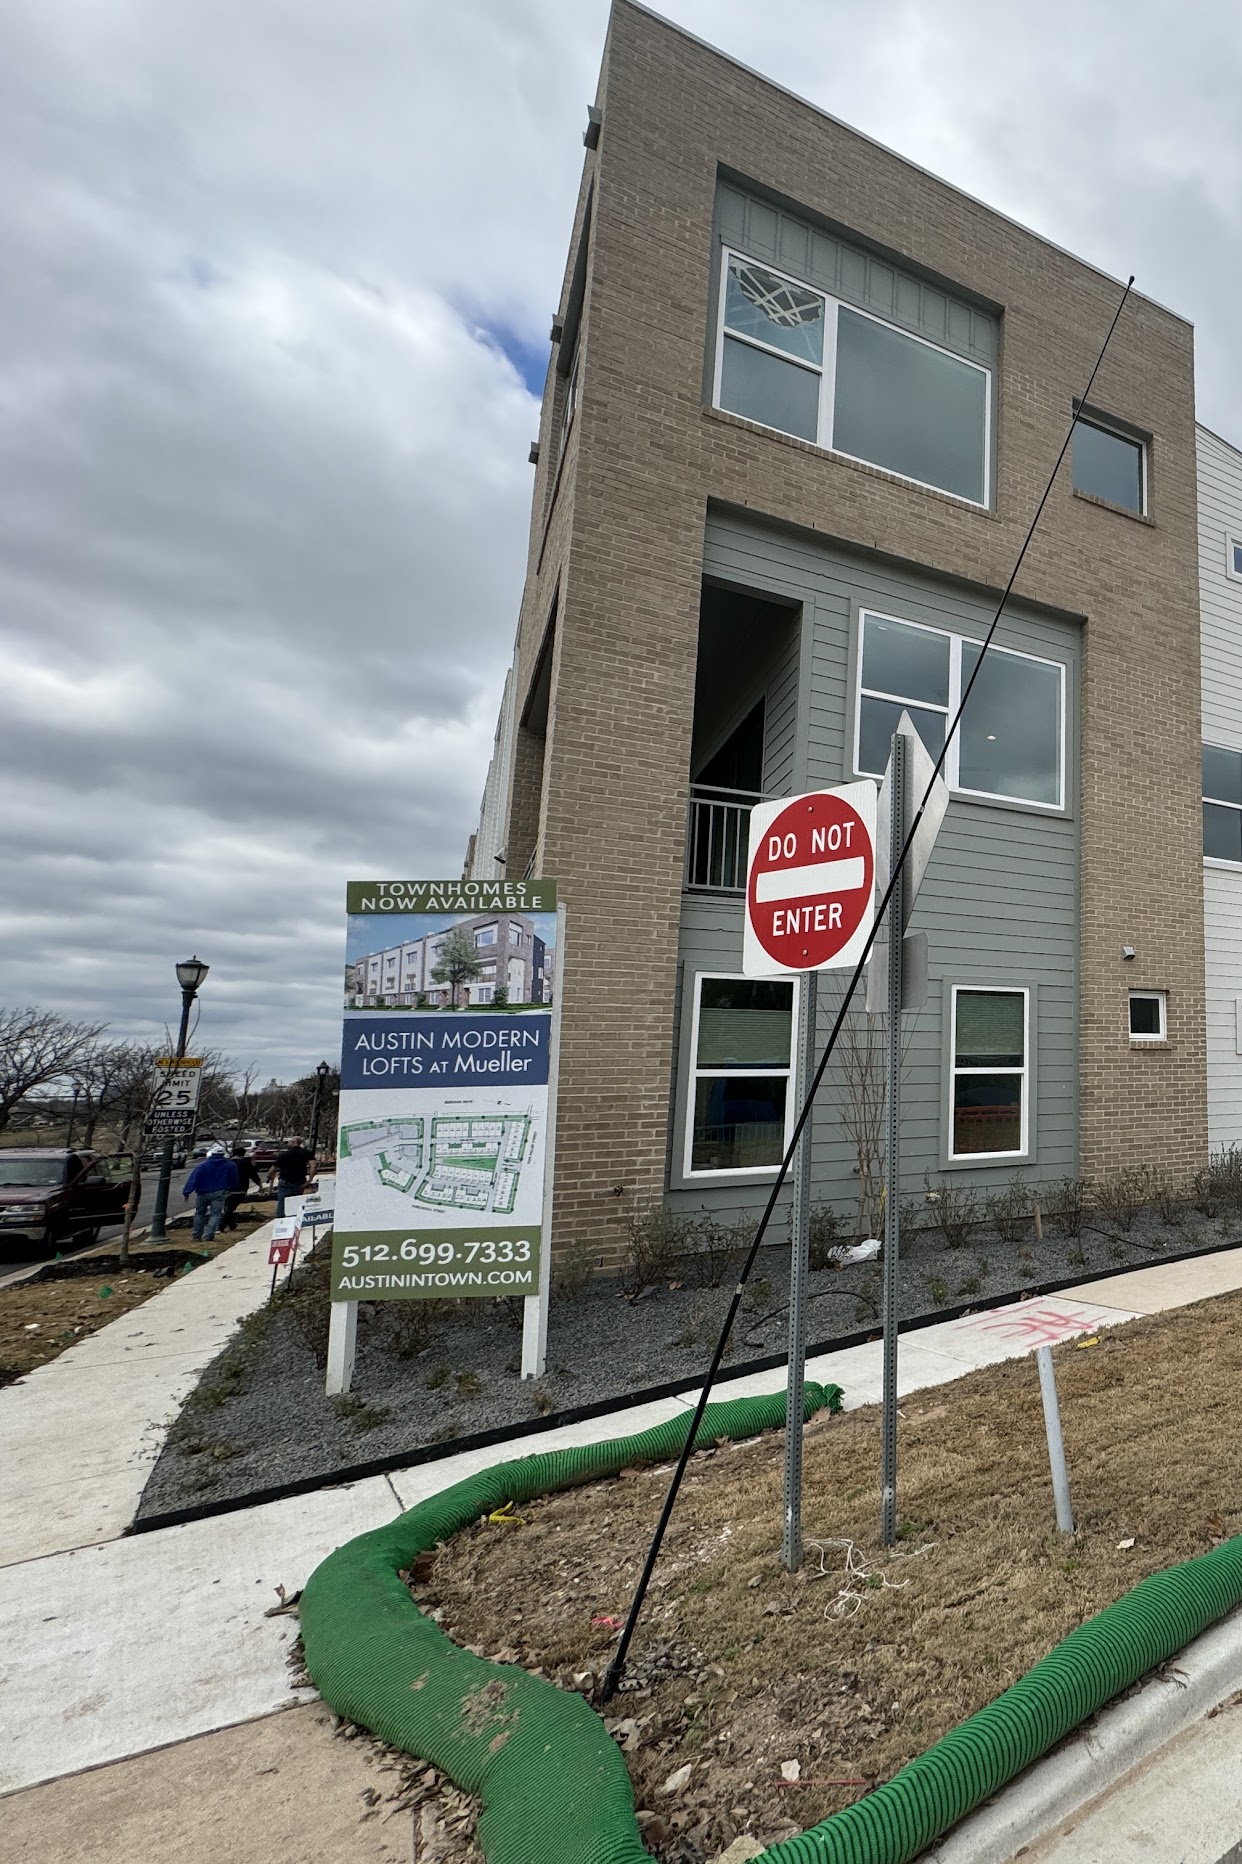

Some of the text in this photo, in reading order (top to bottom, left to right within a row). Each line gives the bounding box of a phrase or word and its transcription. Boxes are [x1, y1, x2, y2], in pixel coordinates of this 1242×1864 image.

[768, 821, 855, 862] DO NOT
[376, 882, 527, 896] TOWNHOMES
[361, 895, 543, 910] NOW AVAILABLE
[772, 903, 843, 937] ENTER
[354, 1029, 540, 1051] AUSTIN MODERN
[362, 1051, 533, 1076] LOFTS AT Mueller
[162, 1079, 191, 1087] IMIT
[158, 1090, 191, 1106] 25
[147, 1117, 193, 1126] OTHERWISE
[154, 1110, 188, 1118] UNLESS
[302, 1212, 334, 1223] AILABL
[342, 1239, 531, 1267] 512.699.7333
[337, 1270, 532, 1290] AUSTININTOWN.COM
